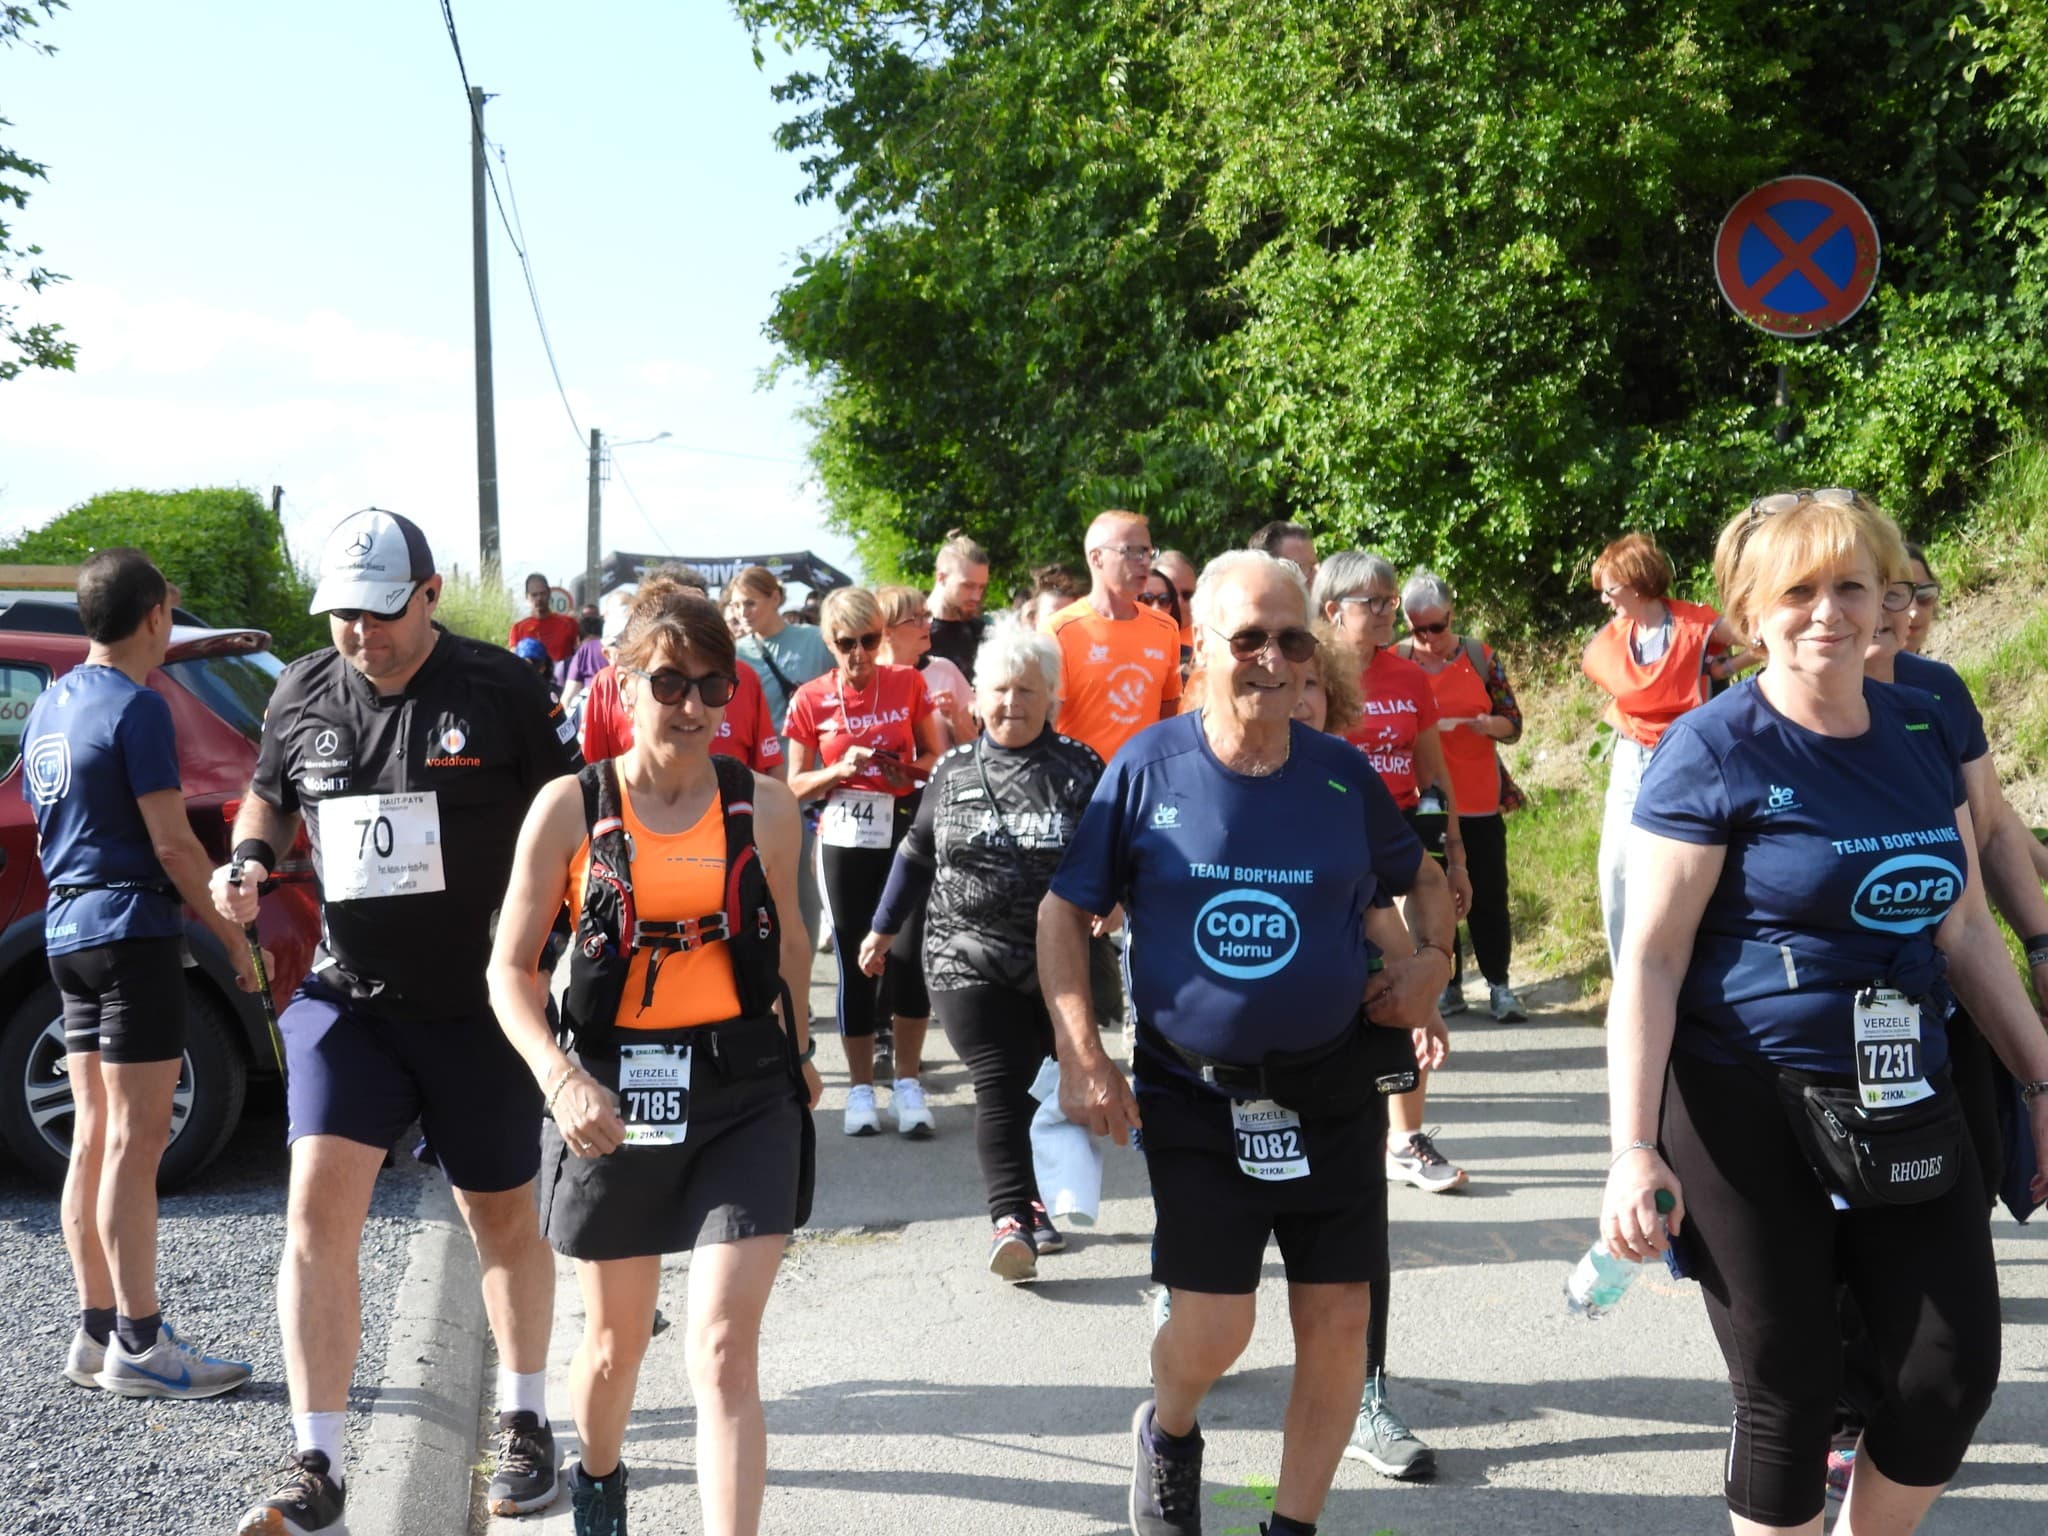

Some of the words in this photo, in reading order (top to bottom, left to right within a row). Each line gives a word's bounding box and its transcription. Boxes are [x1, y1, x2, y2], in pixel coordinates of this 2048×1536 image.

[1363, 699, 1418, 715] ELIAS
[425, 755, 481, 767] vodafone
[841, 800, 875, 826] 144
[354, 815, 394, 860] 70
[1832, 837, 1880, 855] TEAM
[1881, 827, 1959, 850] BOR'HAINE
[1189, 863, 1230, 880] TEAM
[1234, 867, 1314, 884] BOR'HAINE
[1869, 876, 1955, 905] cora
[1206, 911, 1287, 939] cora
[1219, 941, 1272, 958] Hornu
[1863, 1017, 1911, 1028] VERZELE
[629, 1068, 679, 1078] VERZELE
[1864, 1043, 1914, 1080] 7231
[627, 1091, 681, 1121] 7185
[1238, 1110, 1288, 1122] VERZELE
[1239, 1130, 1301, 1160] 7082
[1890, 1155, 1943, 1182] RHODES
